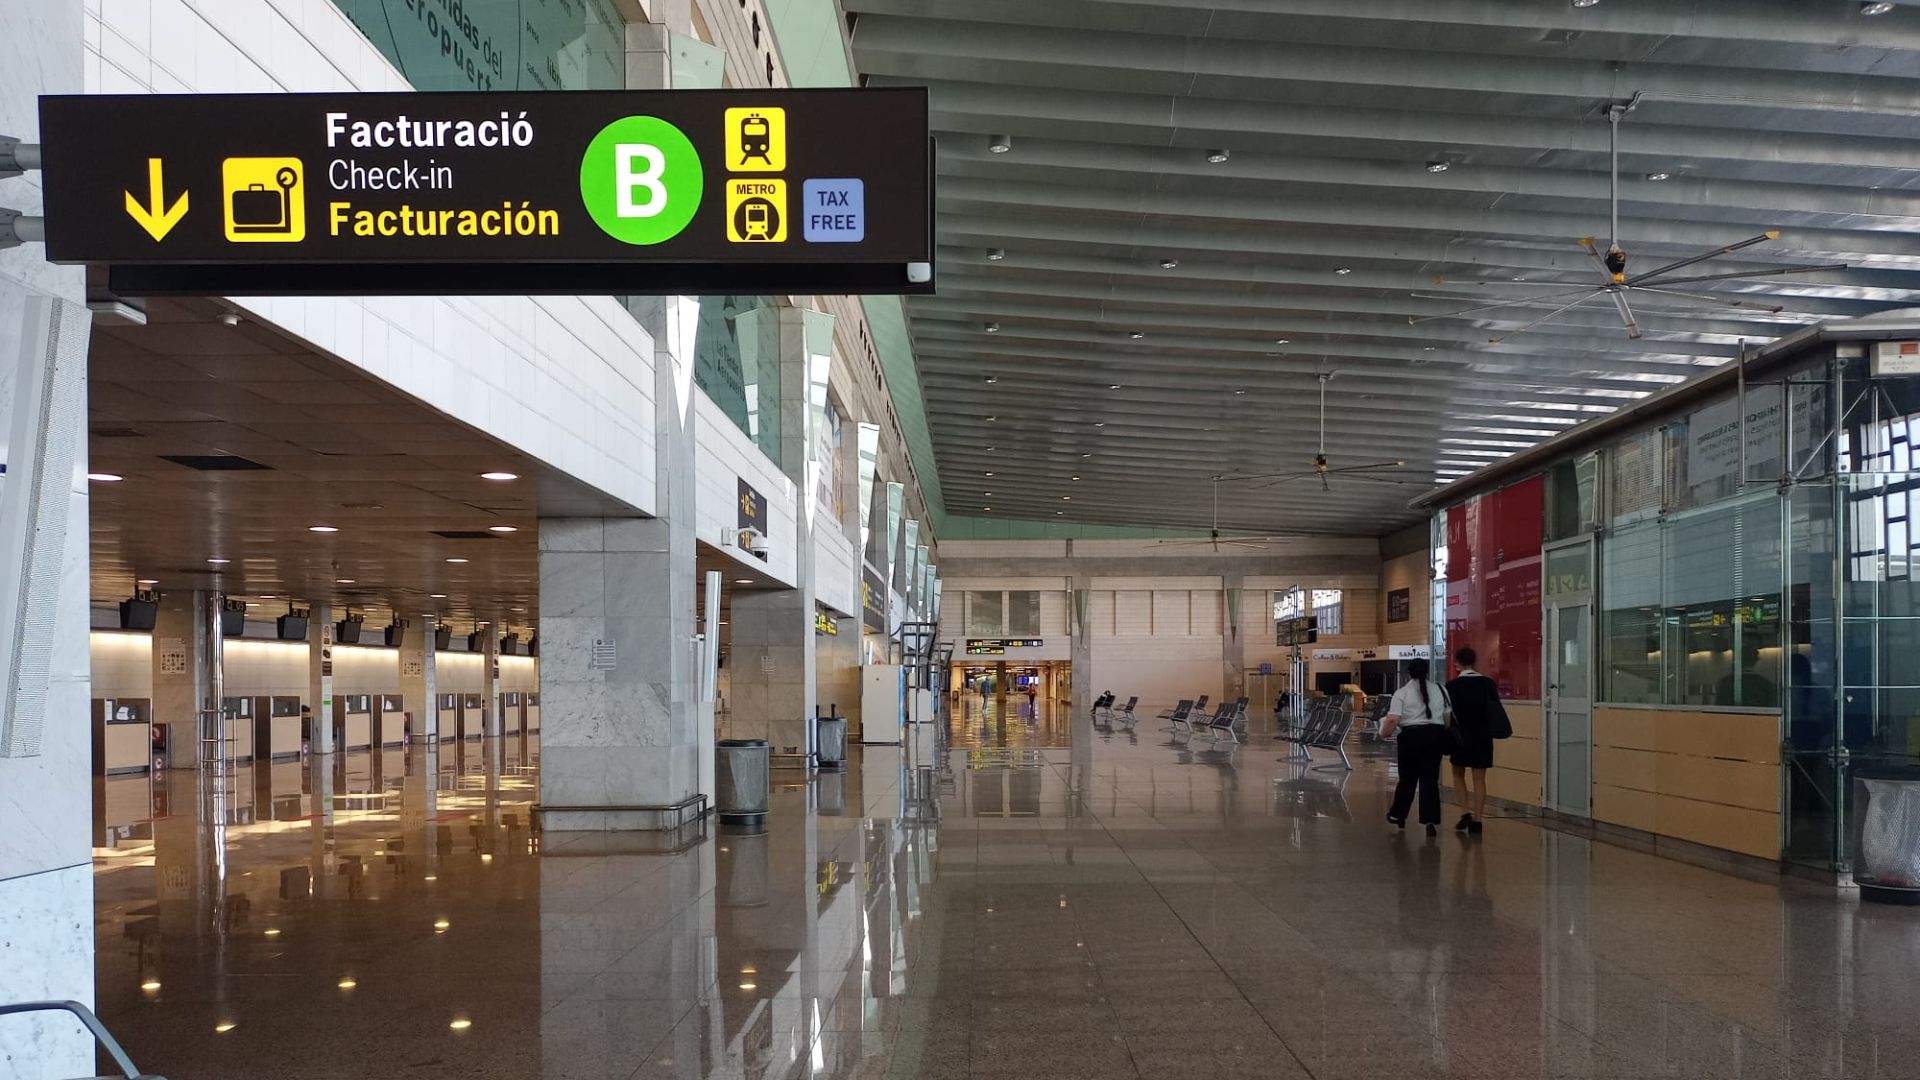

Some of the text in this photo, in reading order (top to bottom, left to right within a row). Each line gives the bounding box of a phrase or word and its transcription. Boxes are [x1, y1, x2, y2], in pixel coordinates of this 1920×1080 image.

[483, 36, 502, 80] del
[326, 111, 533, 147] Facturació
[328, 159, 453, 190] Check-in
[614, 143, 668, 218] B
[736, 184, 776, 195] METRO
[817, 190, 849, 207] TAX
[329, 201, 559, 236] Facturación
[811, 214, 856, 230] FREE
